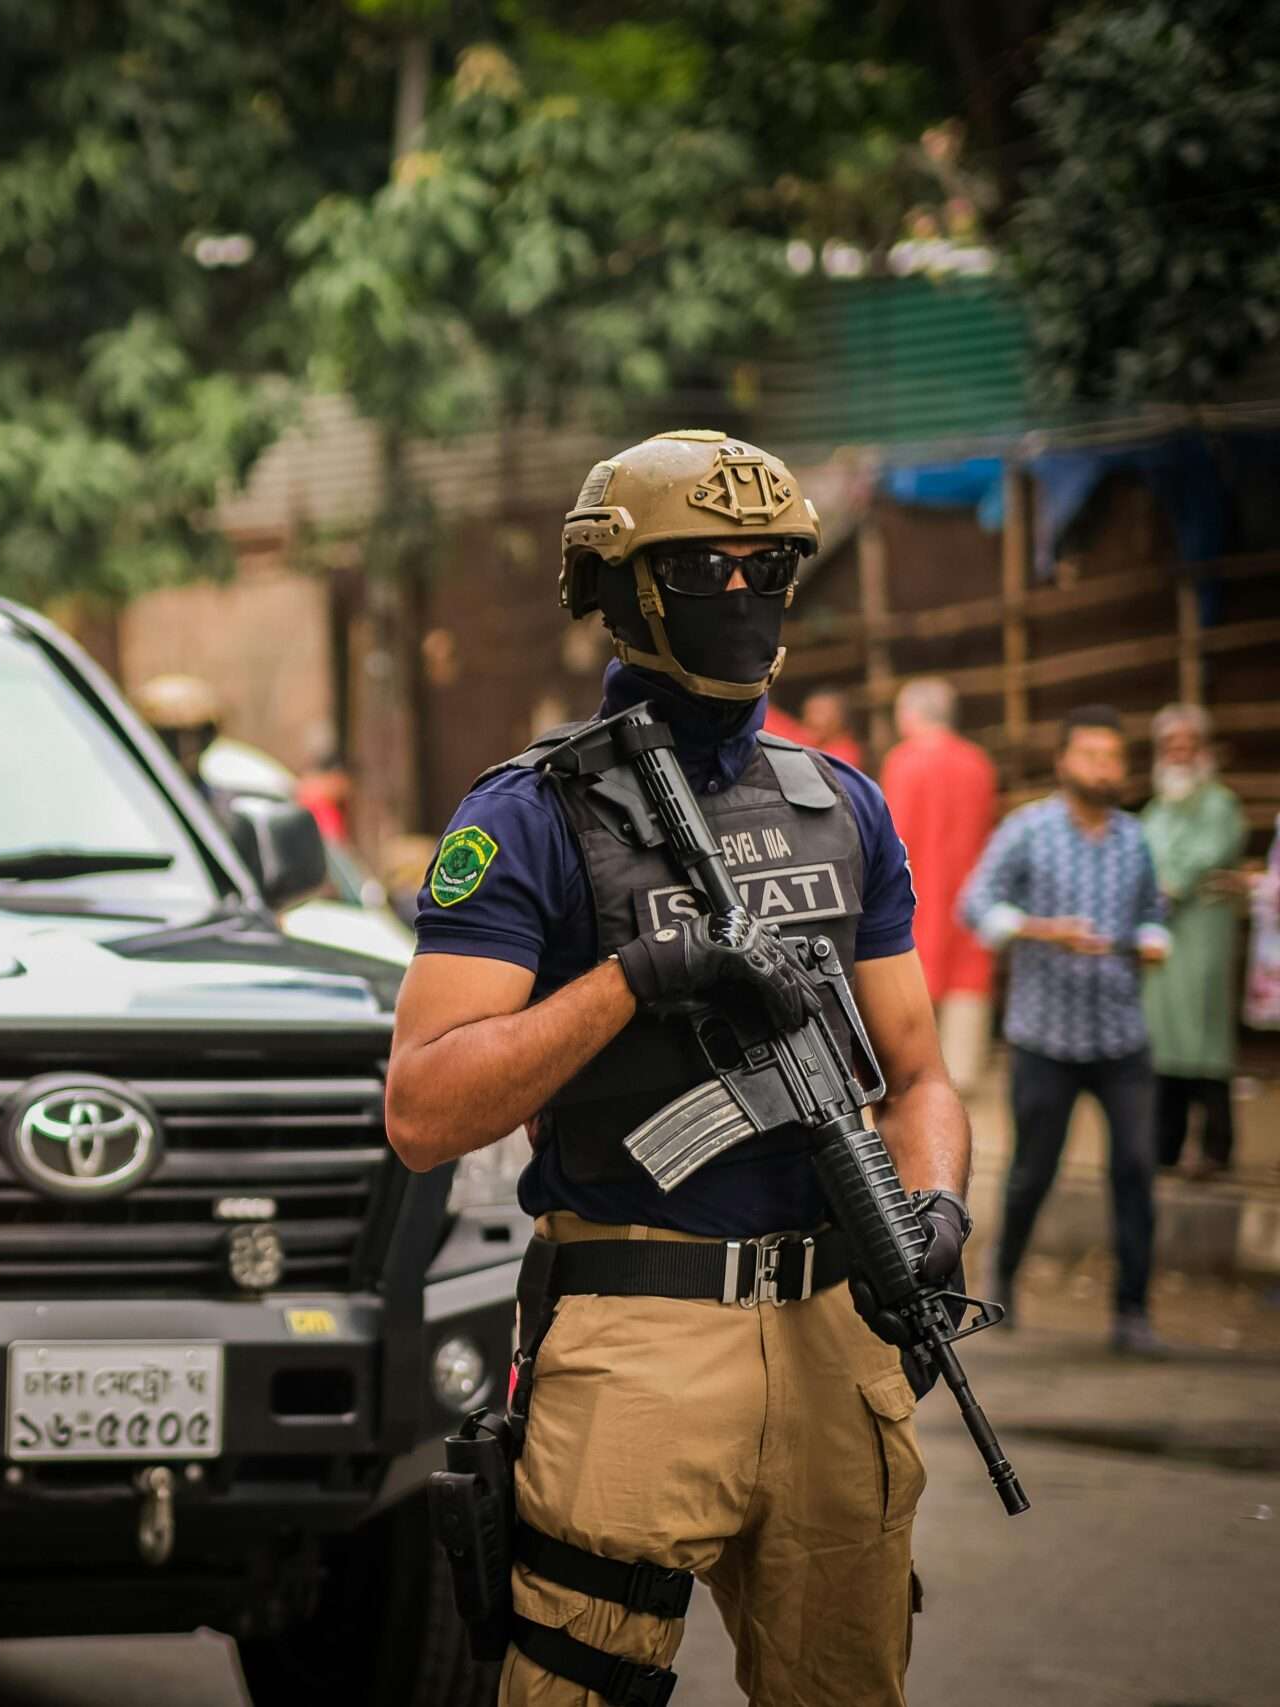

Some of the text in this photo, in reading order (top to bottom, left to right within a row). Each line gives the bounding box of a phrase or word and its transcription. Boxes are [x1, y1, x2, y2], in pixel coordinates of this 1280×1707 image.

[721, 827, 792, 867] EVEL IIIA
[667, 873, 820, 919] SAT
